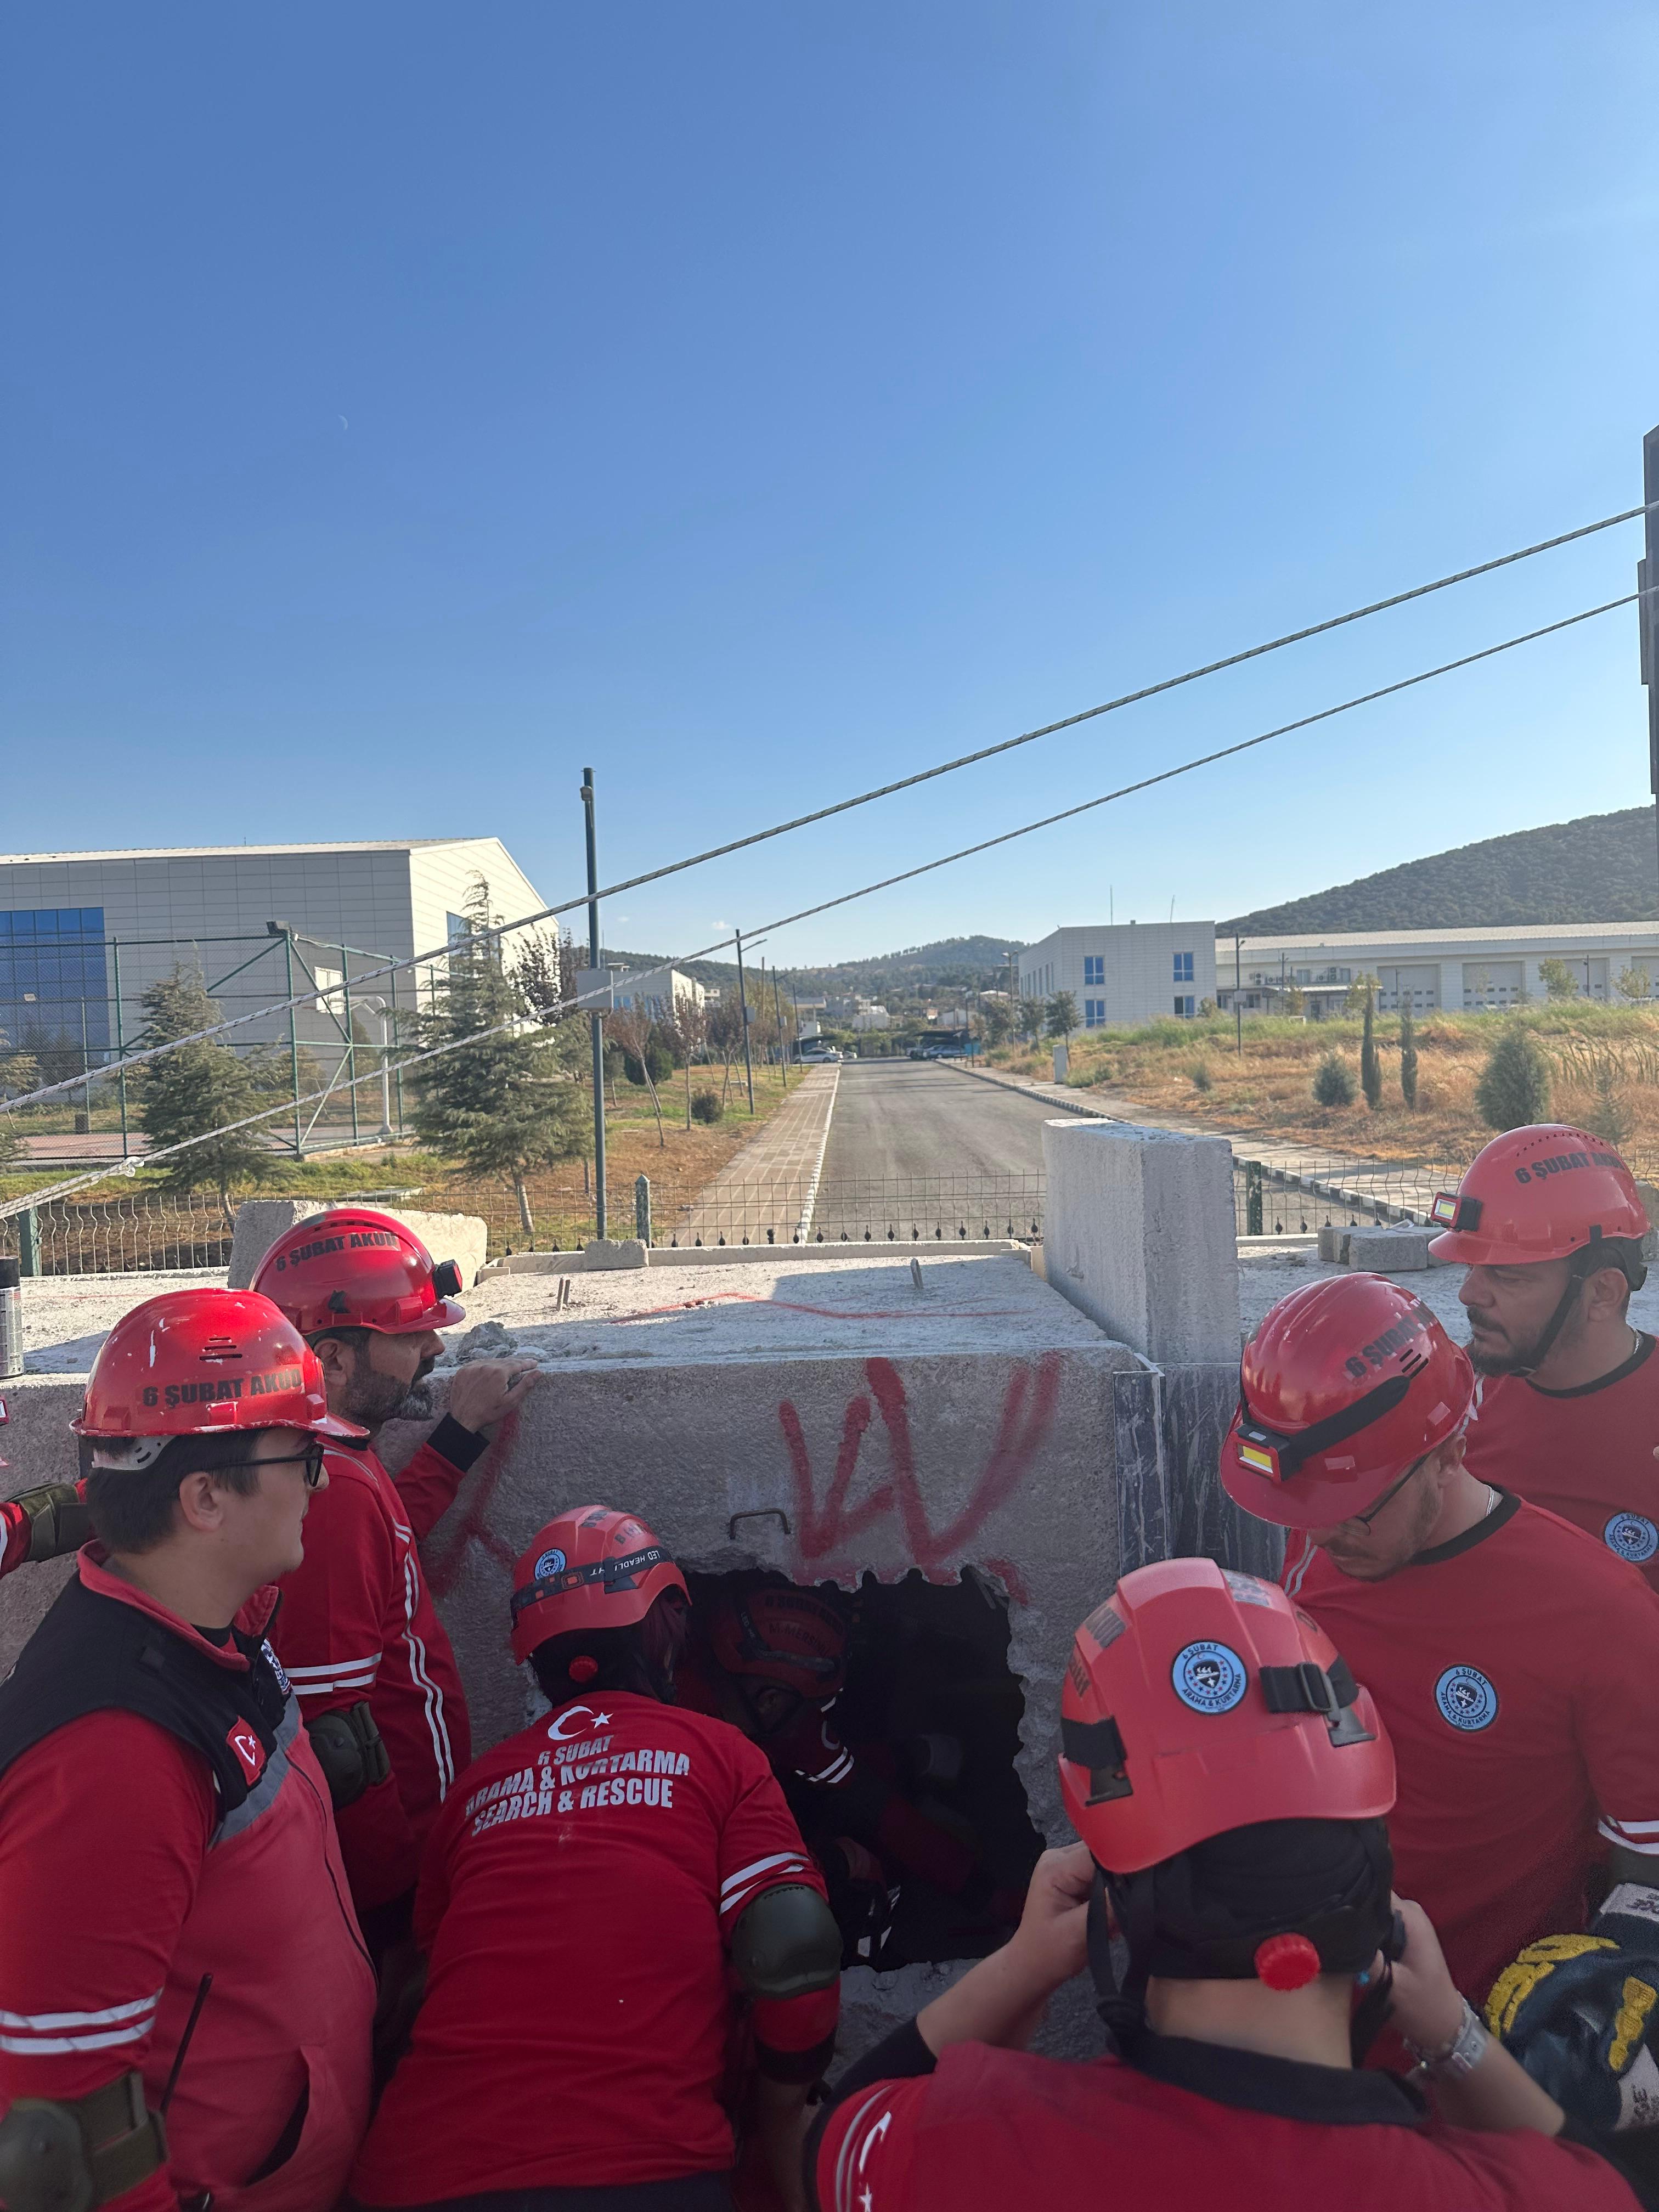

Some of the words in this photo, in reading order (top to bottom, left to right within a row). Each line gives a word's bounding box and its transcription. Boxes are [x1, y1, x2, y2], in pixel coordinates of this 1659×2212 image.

[1515, 1167, 1532, 1184] 6
[1531, 1152, 1590, 1180] ŞUBAT
[275, 1255, 286, 1272] 6
[289, 1235, 346, 1267] ŞUBAT
[1345, 1356, 1367, 1378] 6
[143, 1386, 159, 1407] 6
[165, 1378, 245, 1409] ŞUBAT
[590, 1556, 646, 1576] HEADLIHT
[647, 1550, 661, 1561] LED
[1182, 1688, 1206, 1707] ARAMA
[1215, 1673, 1242, 1706] KURTARMA
[1440, 1691, 1453, 1715] ARAMA
[1458, 1710, 1491, 1725] KURTARMA
[539, 1765, 556, 1792] &
[471, 1790, 552, 1838] SEARCH
[557, 1790, 574, 1813] &
[579, 1778, 674, 1809] RESCUE
